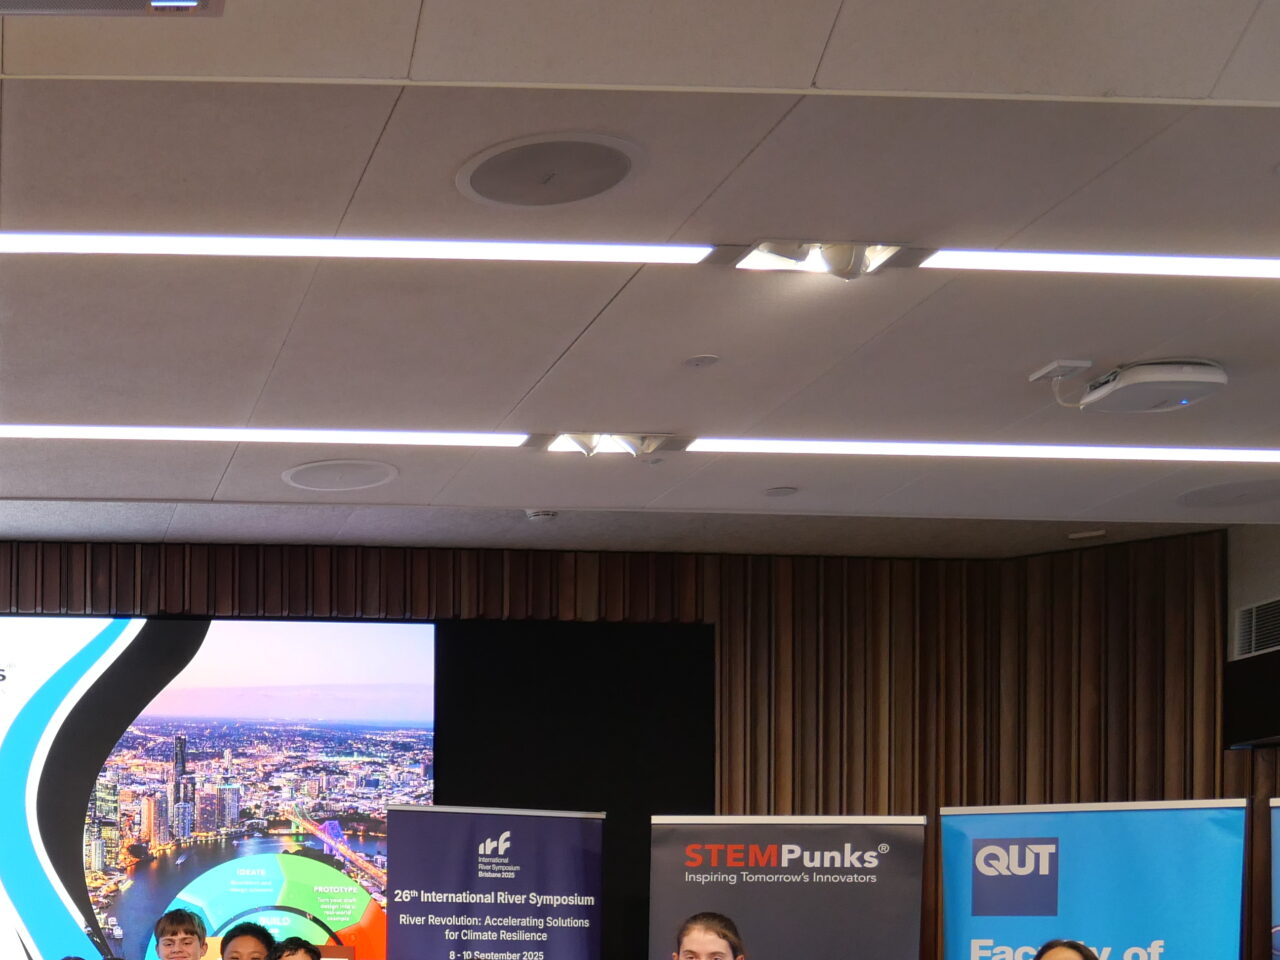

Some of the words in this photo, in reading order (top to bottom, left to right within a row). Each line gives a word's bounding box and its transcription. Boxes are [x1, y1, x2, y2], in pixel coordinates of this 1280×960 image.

[975, 844, 1056, 876] QUT
[492, 864, 520, 872] Symposium
[685, 871, 737, 885] Inspiring
[813, 872, 877, 883] Innovators
[394, 889, 418, 902] 26th
[420, 890, 494, 903] International
[497, 892, 526, 904] River
[529, 893, 595, 907] Symposium
[399, 914, 425, 924] River
[428, 914, 481, 926] Revolution:
[484, 916, 544, 928] Accelerating
[546, 917, 590, 927] Solutions
[445, 929, 458, 940] for
[461, 930, 497, 941] Climate
[500, 930, 548, 941] Resilience
[449, 951, 456, 960] 8
[463, 951, 472, 960] 10
[474, 951, 520, 960] September
[522, 951, 544, 960] 2025
